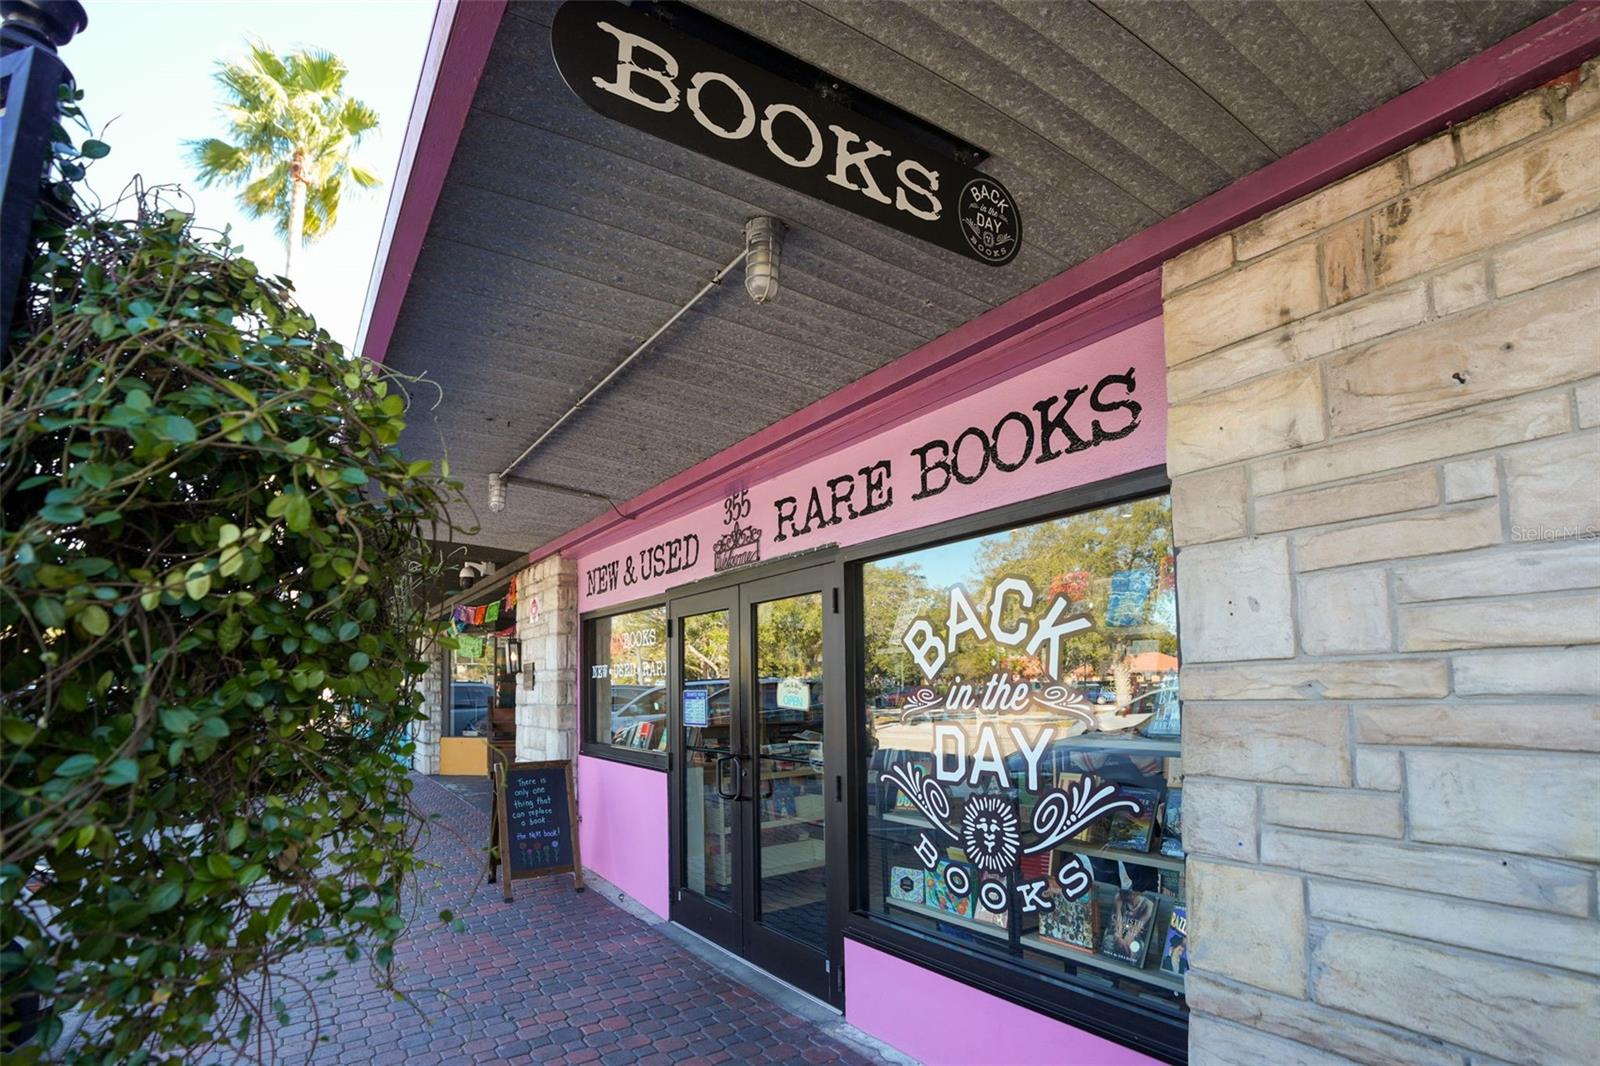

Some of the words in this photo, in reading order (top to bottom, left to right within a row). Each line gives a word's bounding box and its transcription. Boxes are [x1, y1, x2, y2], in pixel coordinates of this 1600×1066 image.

[592, 21, 942, 221] BOOKS
[970, 185, 1009, 214] BACK
[976, 212, 1002, 234] DAY
[970, 236, 1007, 257] BOOKS
[774, 460, 894, 543] RARE
[911, 367, 1143, 501] BOOKS
[723, 489, 752, 526] 355
[586, 559, 620, 598] NEW
[623, 555, 638, 586] &
[640, 533, 700, 581] USED
[622, 628, 657, 650] BOOKS
[903, 577, 1092, 680] BACK
[592, 664, 608, 679] NEW
[945, 676, 975, 711] in
[981, 673, 1030, 711] the
[934, 726, 1054, 791] DAY
[514, 787, 529, 798] only
[532, 786, 545, 795] one
[514, 799, 534, 809] thing
[536, 795, 551, 805] that
[512, 811, 526, 819] can
[528, 807, 553, 818] replace
[913, 833, 1090, 913] BOOKS
